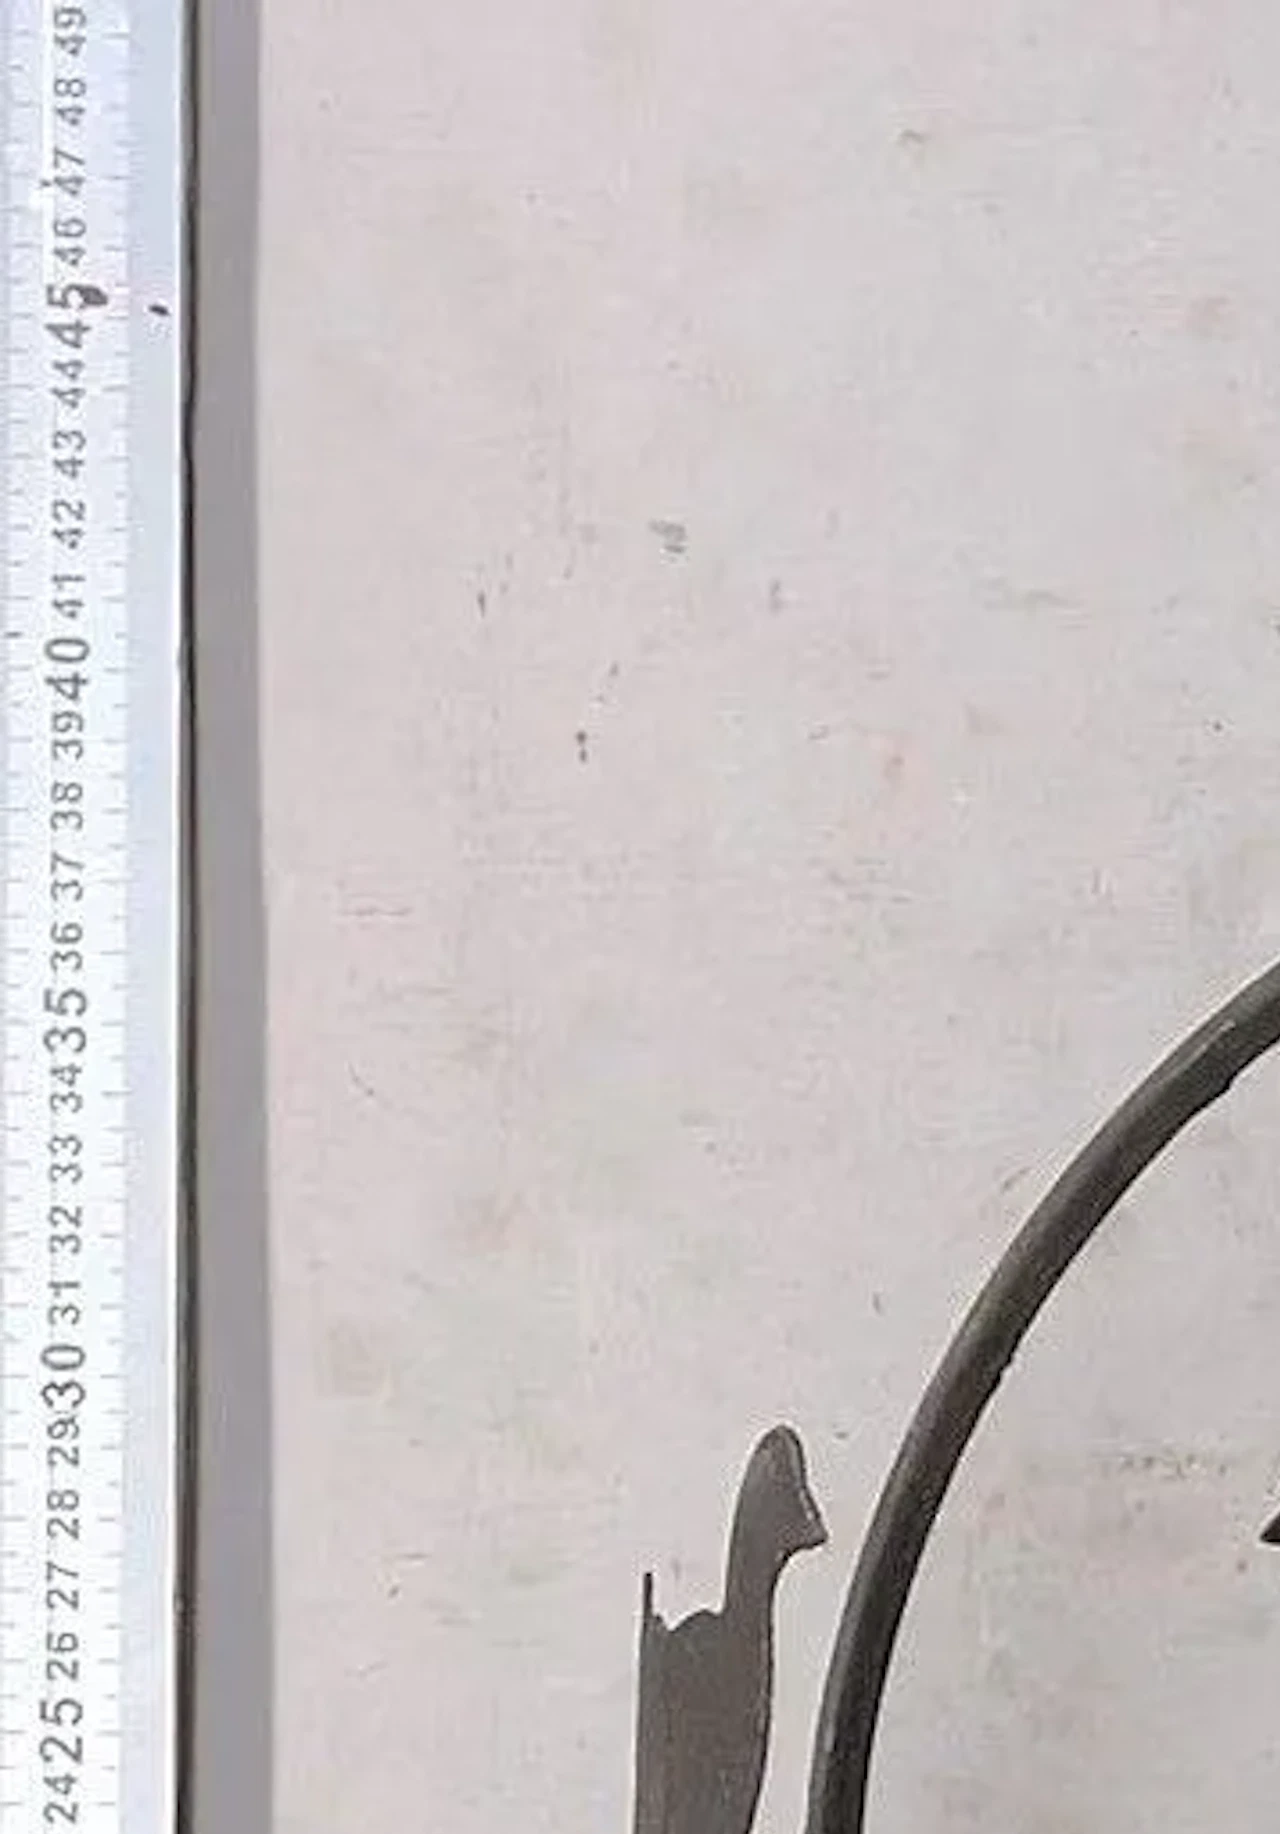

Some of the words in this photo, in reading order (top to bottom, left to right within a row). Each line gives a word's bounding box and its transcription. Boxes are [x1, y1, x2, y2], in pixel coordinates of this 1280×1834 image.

[54, 6, 88, 55] 49
[53, 76, 87, 126] 48
[53, 148, 87, 194] 47
[52, 217, 87, 266] 46
[45, 283, 90, 348] 45
[53, 358, 87, 408] 44
[53, 429, 86, 477] 43
[52, 499, 86, 548] 42
[53, 573, 85, 619] 41
[45, 636, 89, 699] 40
[52, 710, 85, 759] 39
[51, 782, 84, 830] 38
[51, 851, 84, 901] 37
[50, 922, 83, 971] 36
[42, 987, 87, 1053] 35
[49, 1063, 84, 1112] 34
[49, 1133, 83, 1183] 33
[49, 1204, 83, 1254] 32
[48, 1280, 82, 1324] 31
[41, 1344, 85, 1408] 30
[48, 1416, 81, 1465] 29
[47, 1488, 80, 1539] 28
[47, 1561, 80, 1609] 27
[46, 1631, 80, 1681] 26
[38, 1697, 84, 1763] 25
[45, 1773, 79, 1823] 24
